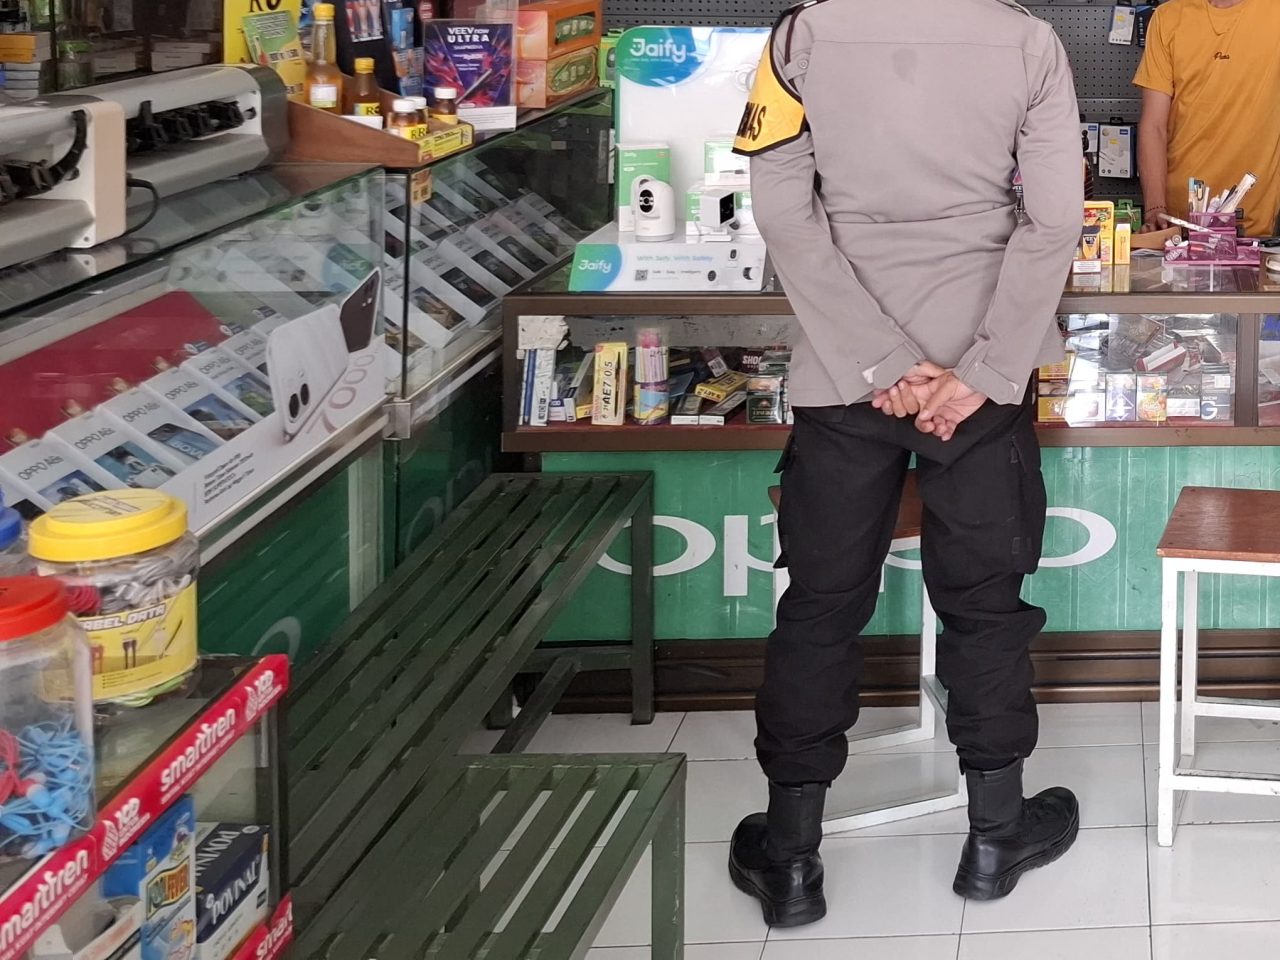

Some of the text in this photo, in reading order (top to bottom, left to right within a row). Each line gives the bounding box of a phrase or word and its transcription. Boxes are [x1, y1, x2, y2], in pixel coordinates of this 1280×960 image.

[447, 34, 490, 43] ULTRA
[630, 38, 686, 62] Jaify
[578, 259, 613, 274] Jaify
[604, 361, 613, 378] 0.5
[122, 407, 146, 423] OPPO
[74, 434, 99, 450] OPPO
[18, 458, 48, 481] OPPO
[126, 604, 166, 624] DATA
[160, 709, 236, 792] smartfren
